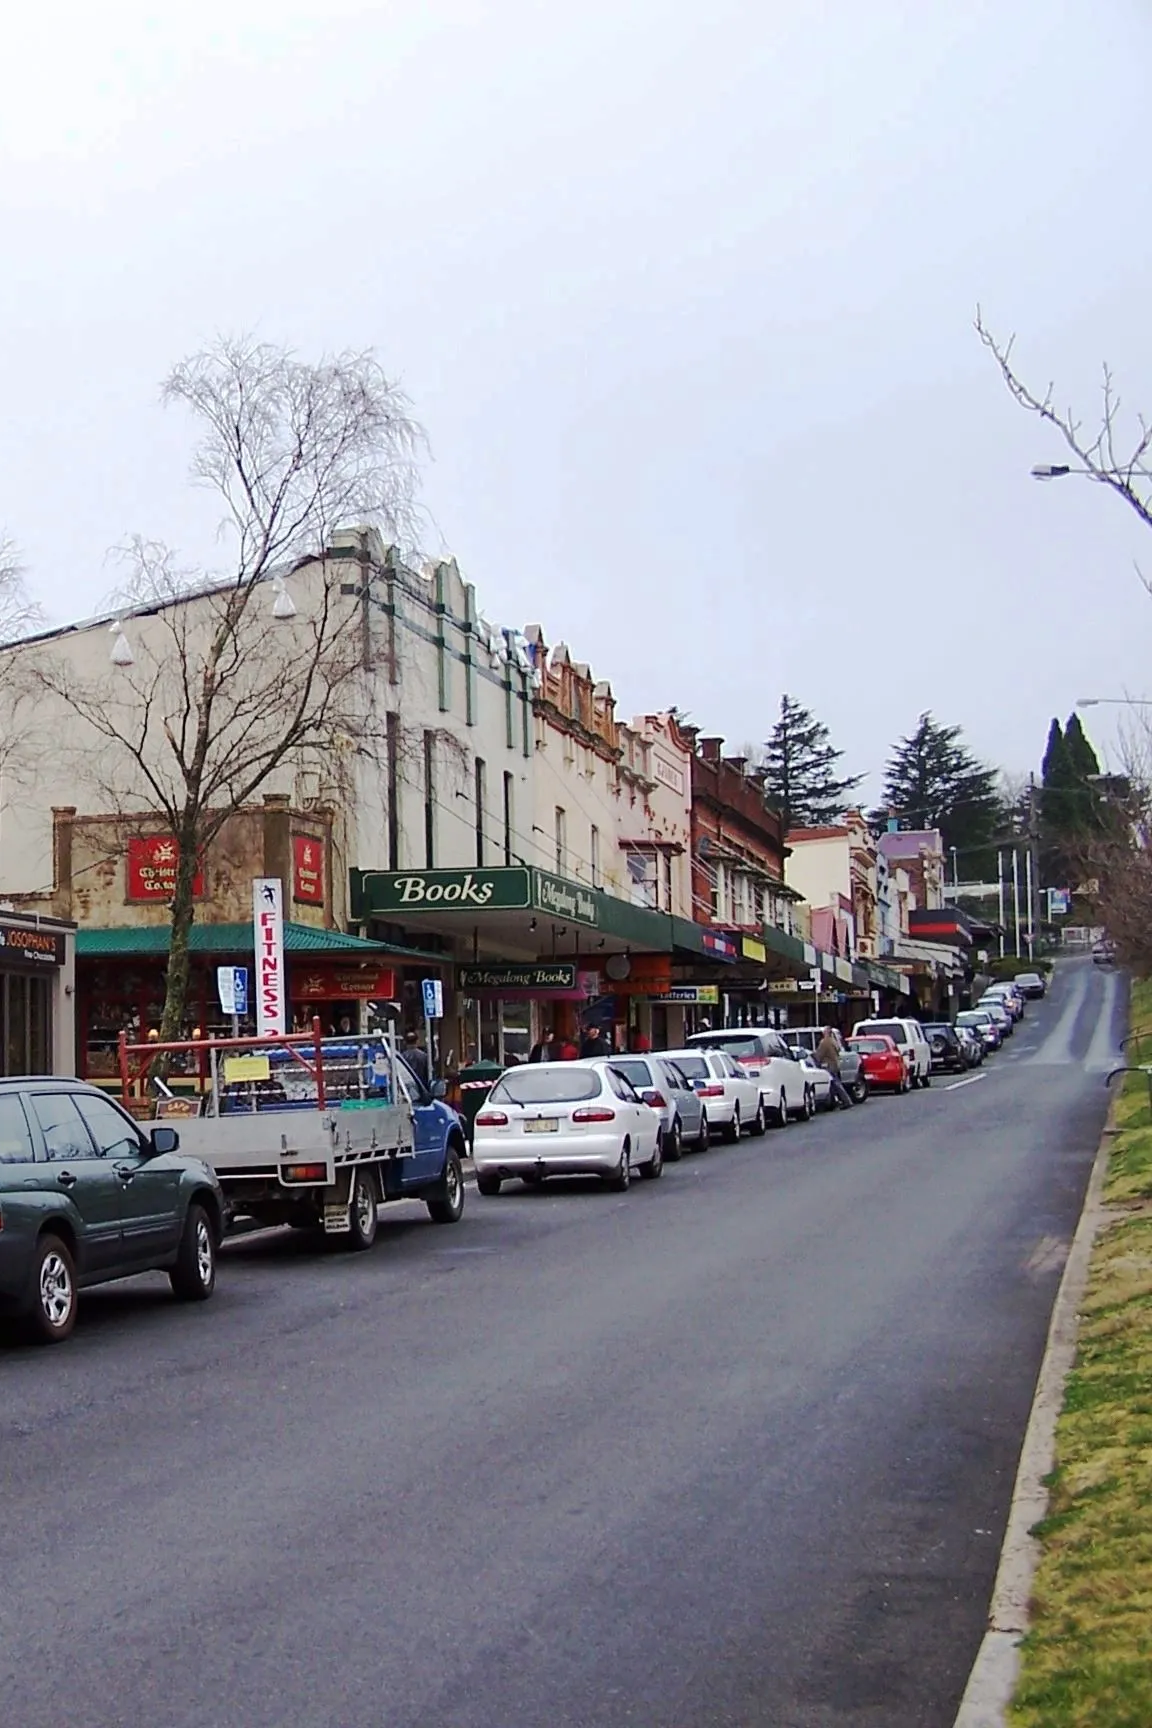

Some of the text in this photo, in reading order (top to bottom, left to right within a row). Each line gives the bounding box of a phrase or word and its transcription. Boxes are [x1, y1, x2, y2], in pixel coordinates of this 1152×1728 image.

[394, 875, 494, 904] Books
[260, 911, 279, 1019] FITNESS
[468, 970, 571, 985] Megalong Books
